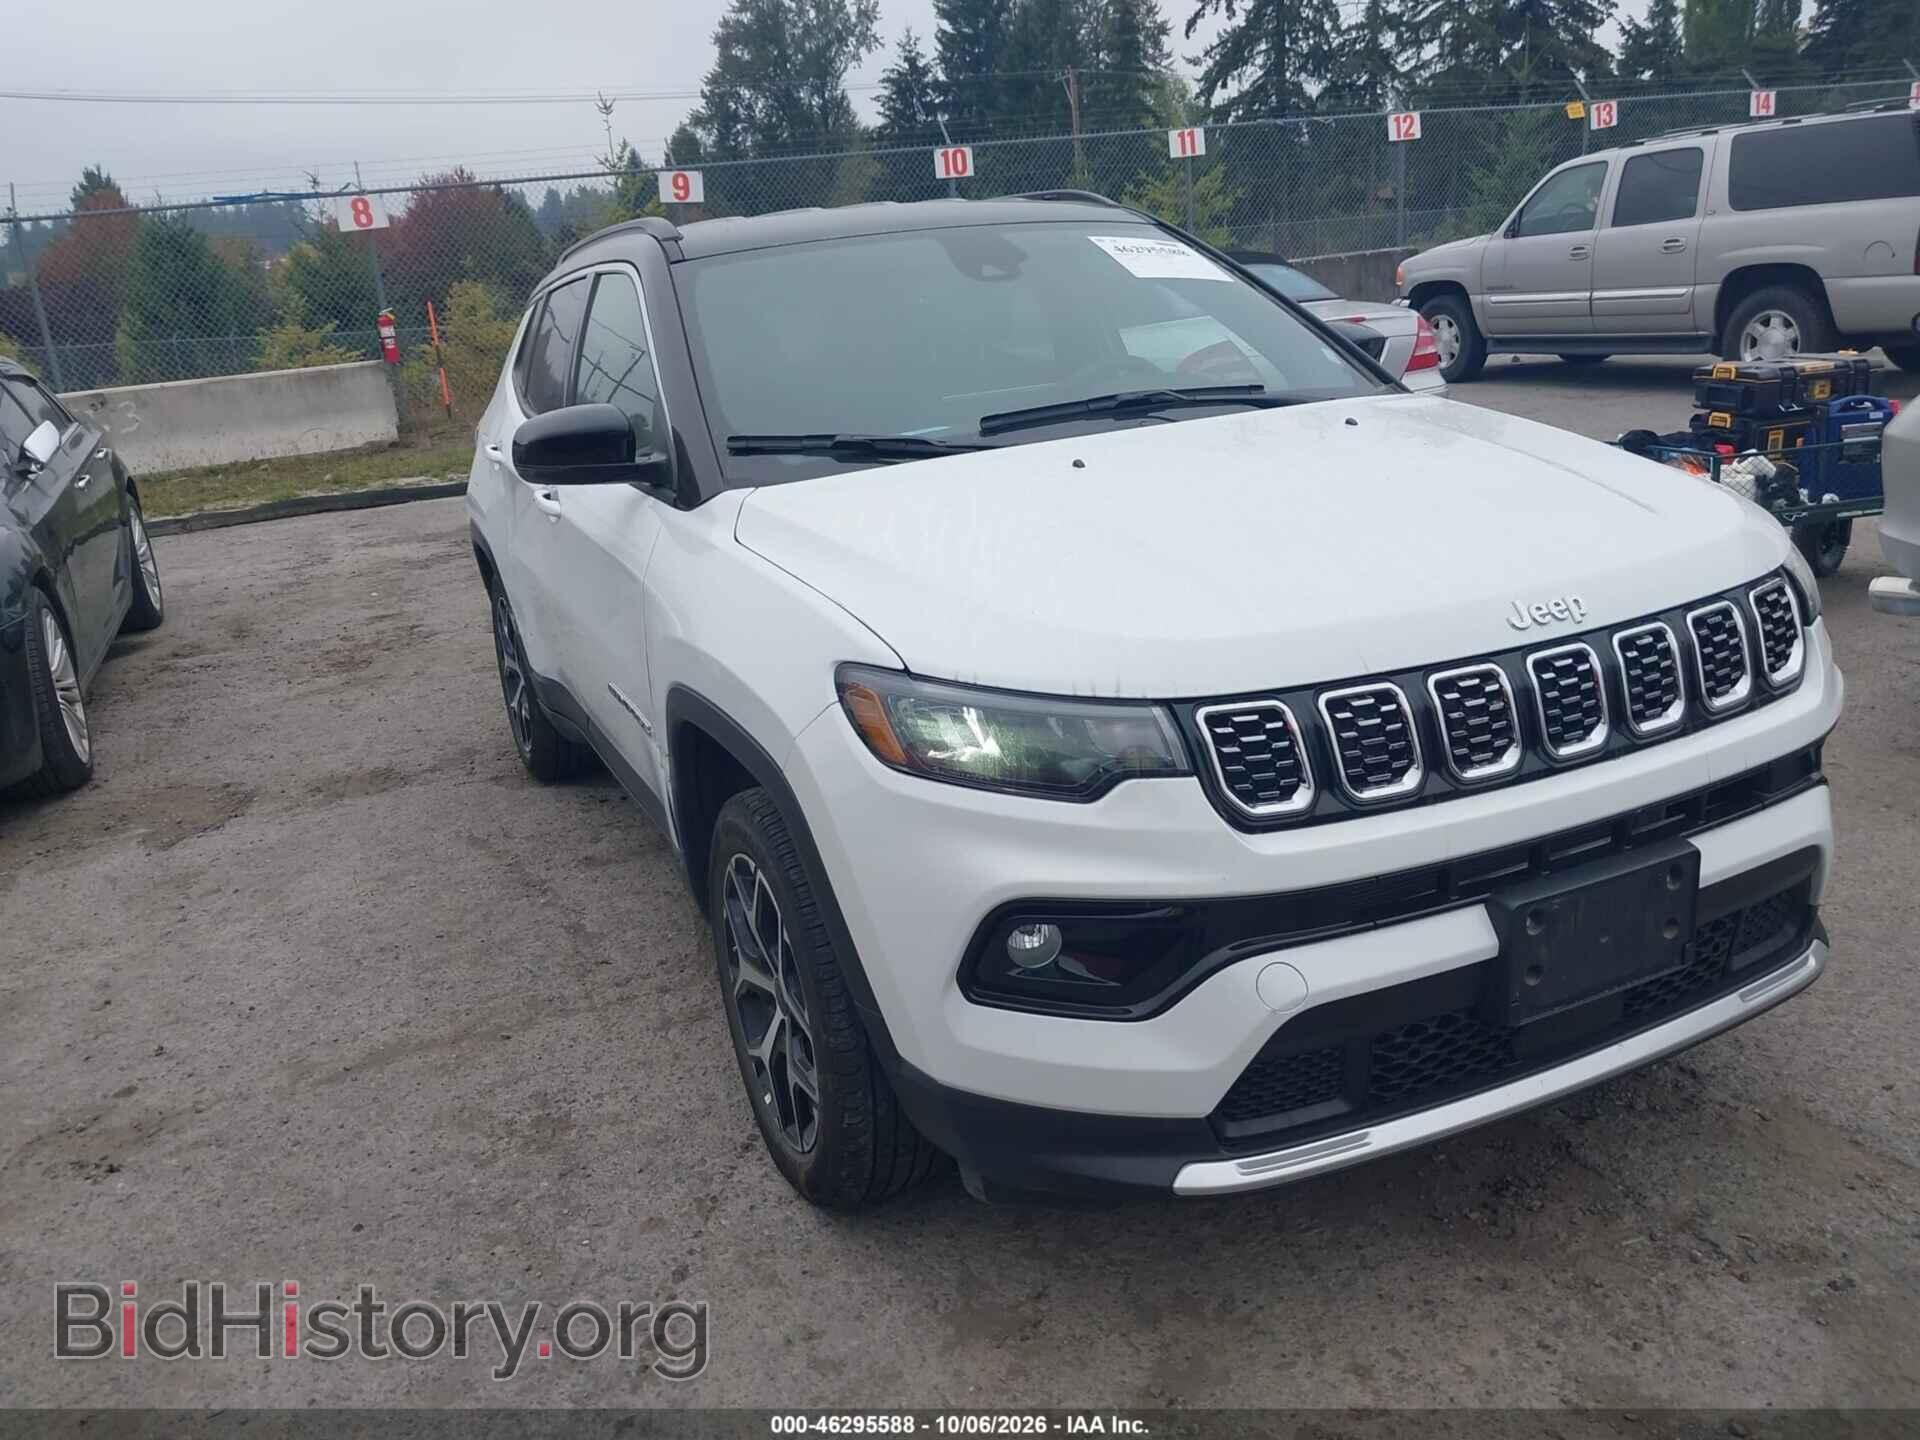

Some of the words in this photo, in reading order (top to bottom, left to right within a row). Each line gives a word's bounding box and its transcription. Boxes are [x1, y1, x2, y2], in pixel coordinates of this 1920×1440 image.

[1595, 103, 1613, 127] 13
[1755, 93, 1771, 114] 14
[1393, 114, 1416, 139] 12
[1177, 130, 1197, 155] 11
[940, 149, 968, 177] 10
[672, 172, 689, 201] 9
[351, 197, 374, 228] 8
[1506, 596, 1586, 631] Jeep
